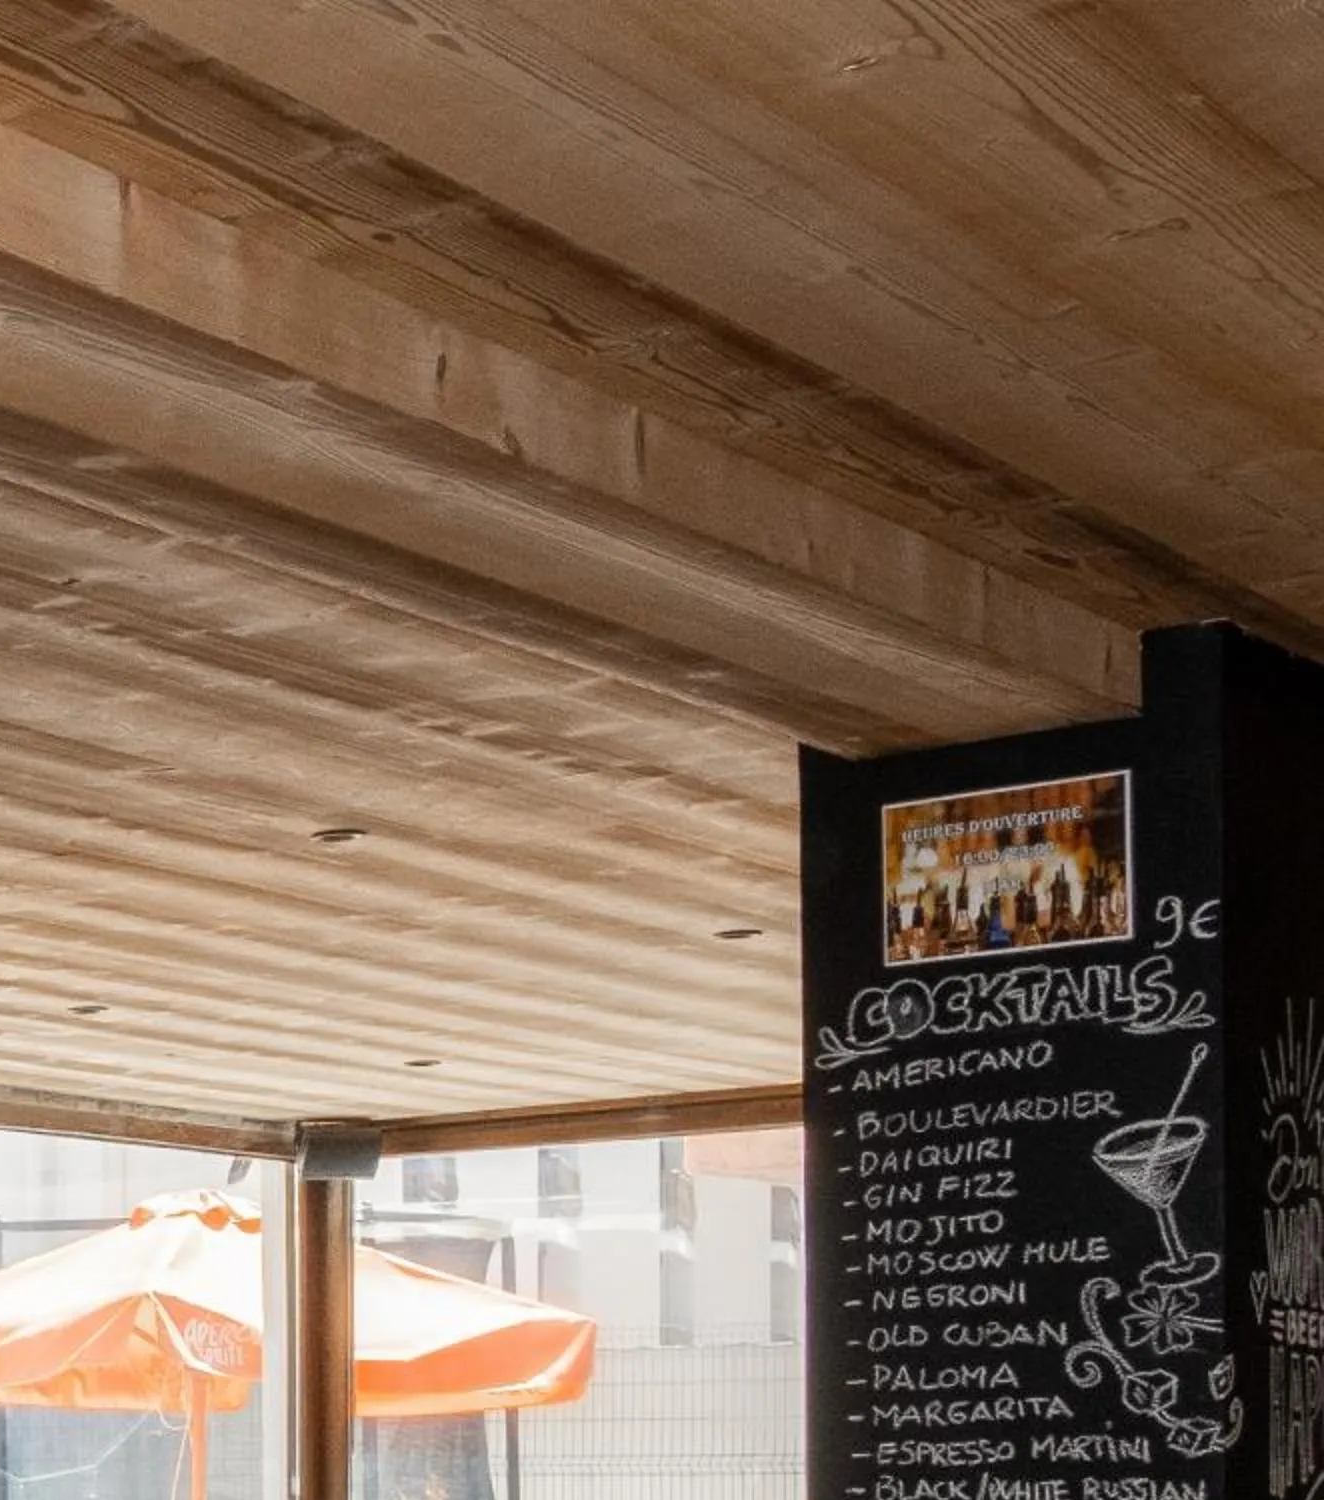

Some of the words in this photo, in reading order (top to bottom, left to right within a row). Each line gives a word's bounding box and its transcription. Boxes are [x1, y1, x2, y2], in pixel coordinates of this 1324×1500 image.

[902, 821, 965, 843] HEURES
[968, 806, 1084, 832] D'OUVERTURE
[1154, 896, 1221, 949] 9€
[847, 954, 1178, 1046] COCKTAILS
[851, 1040, 1054, 1092] AMERICANO
[857, 1090, 1123, 1140] BOULEVARDIER
[859, 1137, 1013, 1178] DAIQUIRI
[863, 1182, 924, 1210] GIN
[937, 1170, 1019, 1200] FIZZ
[866, 1210, 1004, 1245] MOJITO
[867, 1243, 1013, 1276] MOSCOW
[1023, 1236, 1111, 1264] MULE
[873, 1280, 1026, 1312] NEGRONI
[867, 1323, 929, 1351] OLD
[942, 1319, 1069, 1347] CUBAN
[873, 1361, 1020, 1391] PALOMA
[871, 1395, 1075, 1429] MARGARITA
[877, 1438, 1016, 1467] ESPRESSO
[1030, 1433, 1152, 1463] MARTINI
